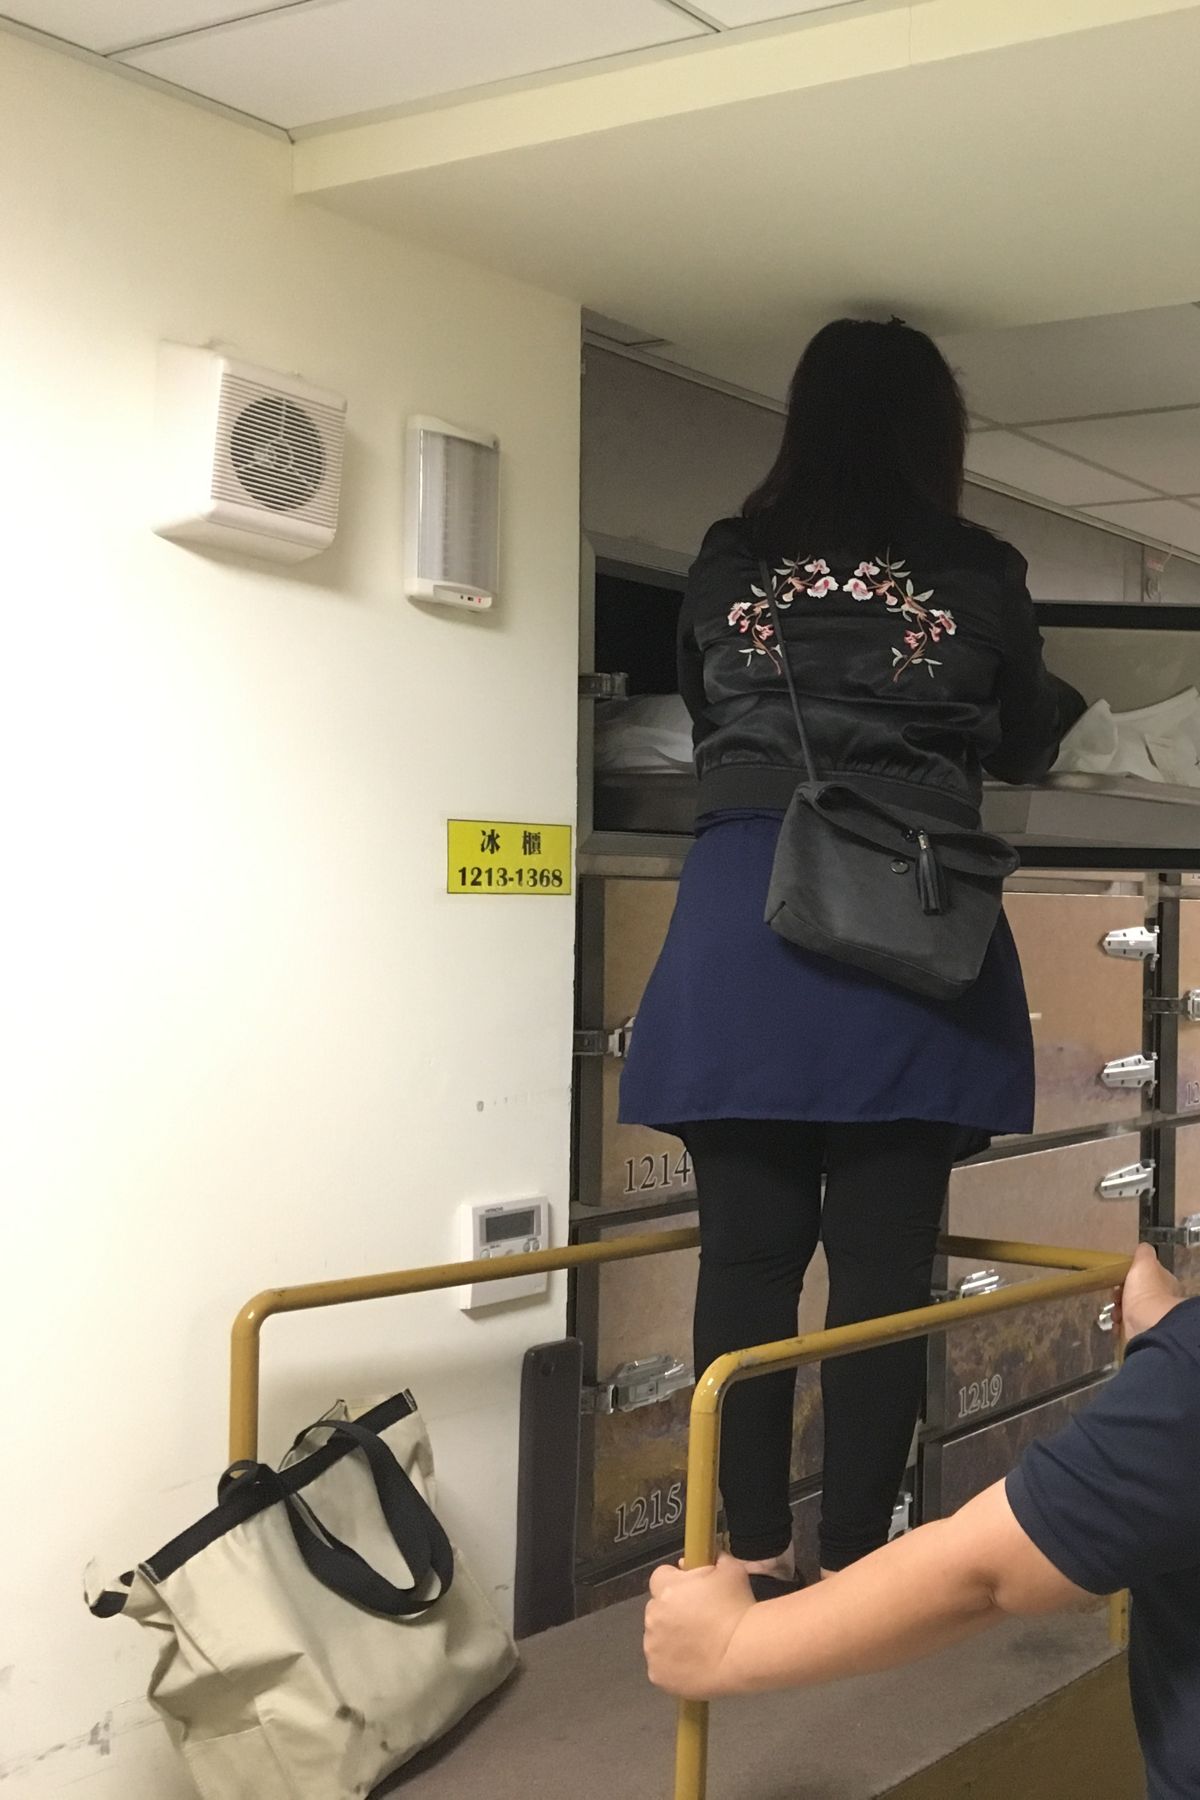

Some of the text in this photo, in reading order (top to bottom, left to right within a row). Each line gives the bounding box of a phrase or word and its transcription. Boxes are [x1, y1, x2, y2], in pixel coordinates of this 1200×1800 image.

[480, 829, 542, 856] 冰櫃
[458, 867, 563, 887] 1213-1368
[624, 1148, 692, 1194] 1214
[958, 1374, 1002, 1418] 1219
[614, 1482, 682, 1543] 1215
